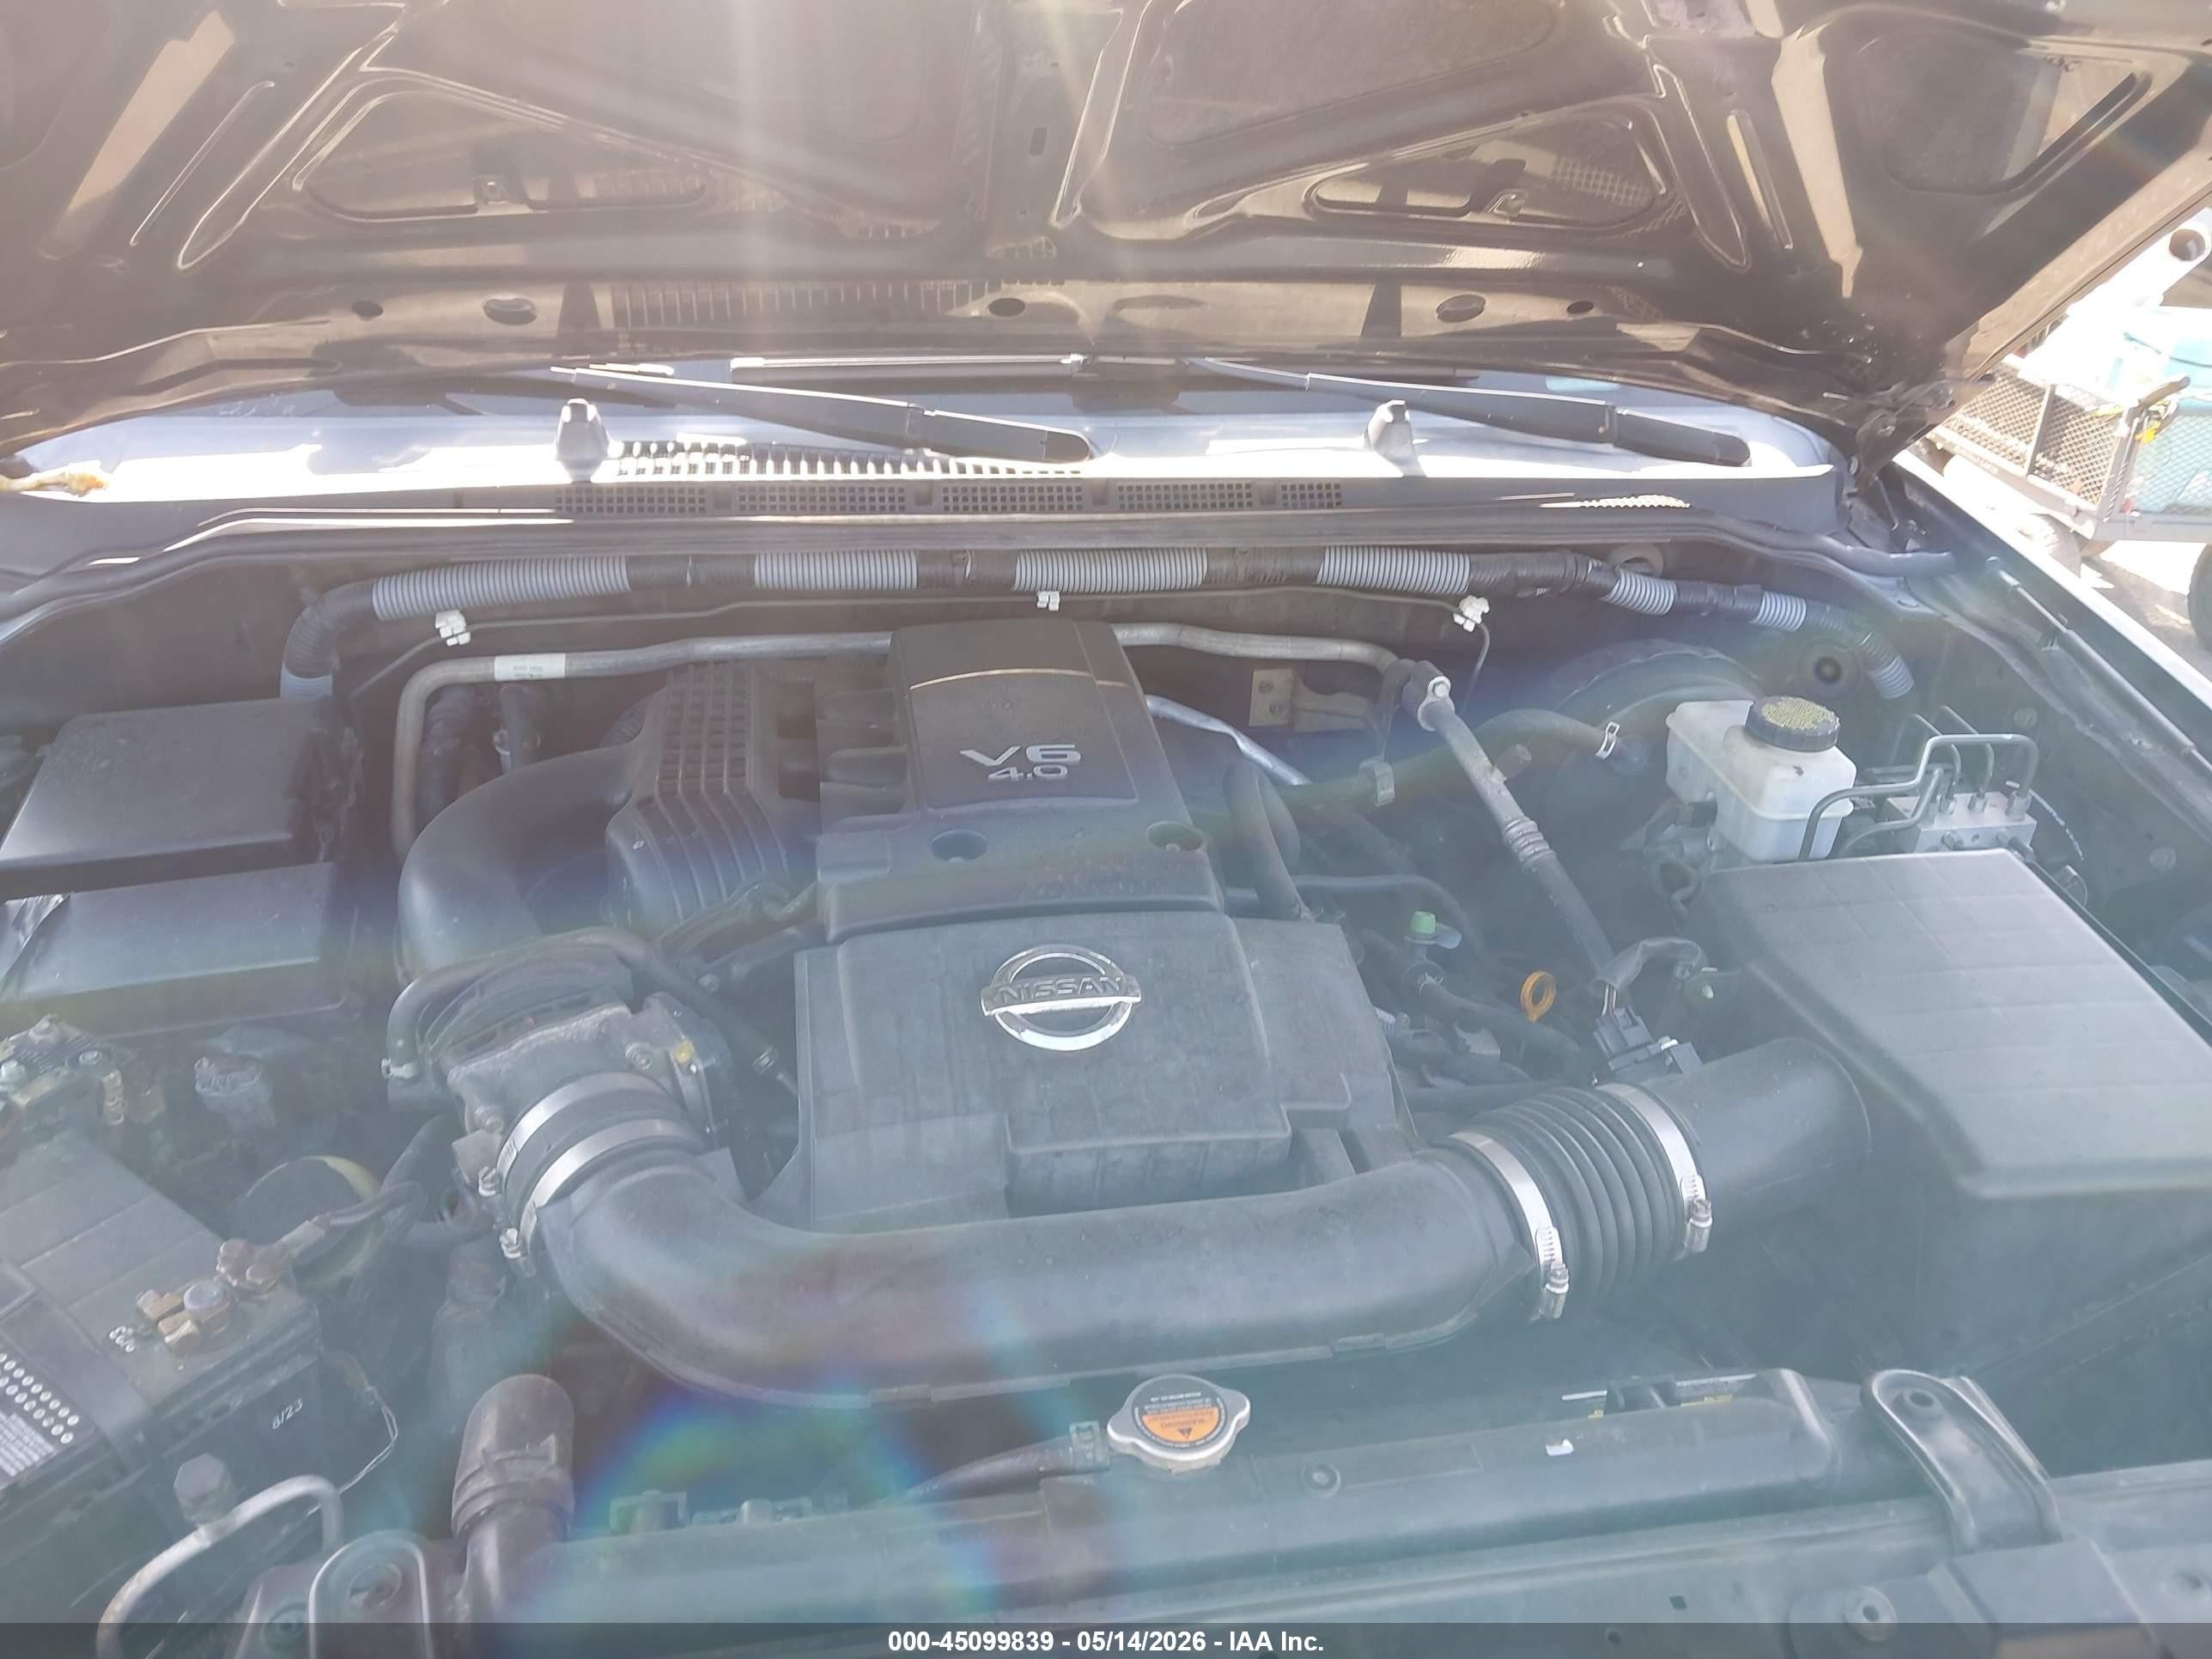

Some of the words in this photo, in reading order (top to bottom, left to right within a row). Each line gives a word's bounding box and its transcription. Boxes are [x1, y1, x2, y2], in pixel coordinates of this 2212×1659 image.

[959, 744, 1081, 766] V6
[988, 764, 1068, 781] 4.0
[997, 976, 1121, 1004] NISSAN
